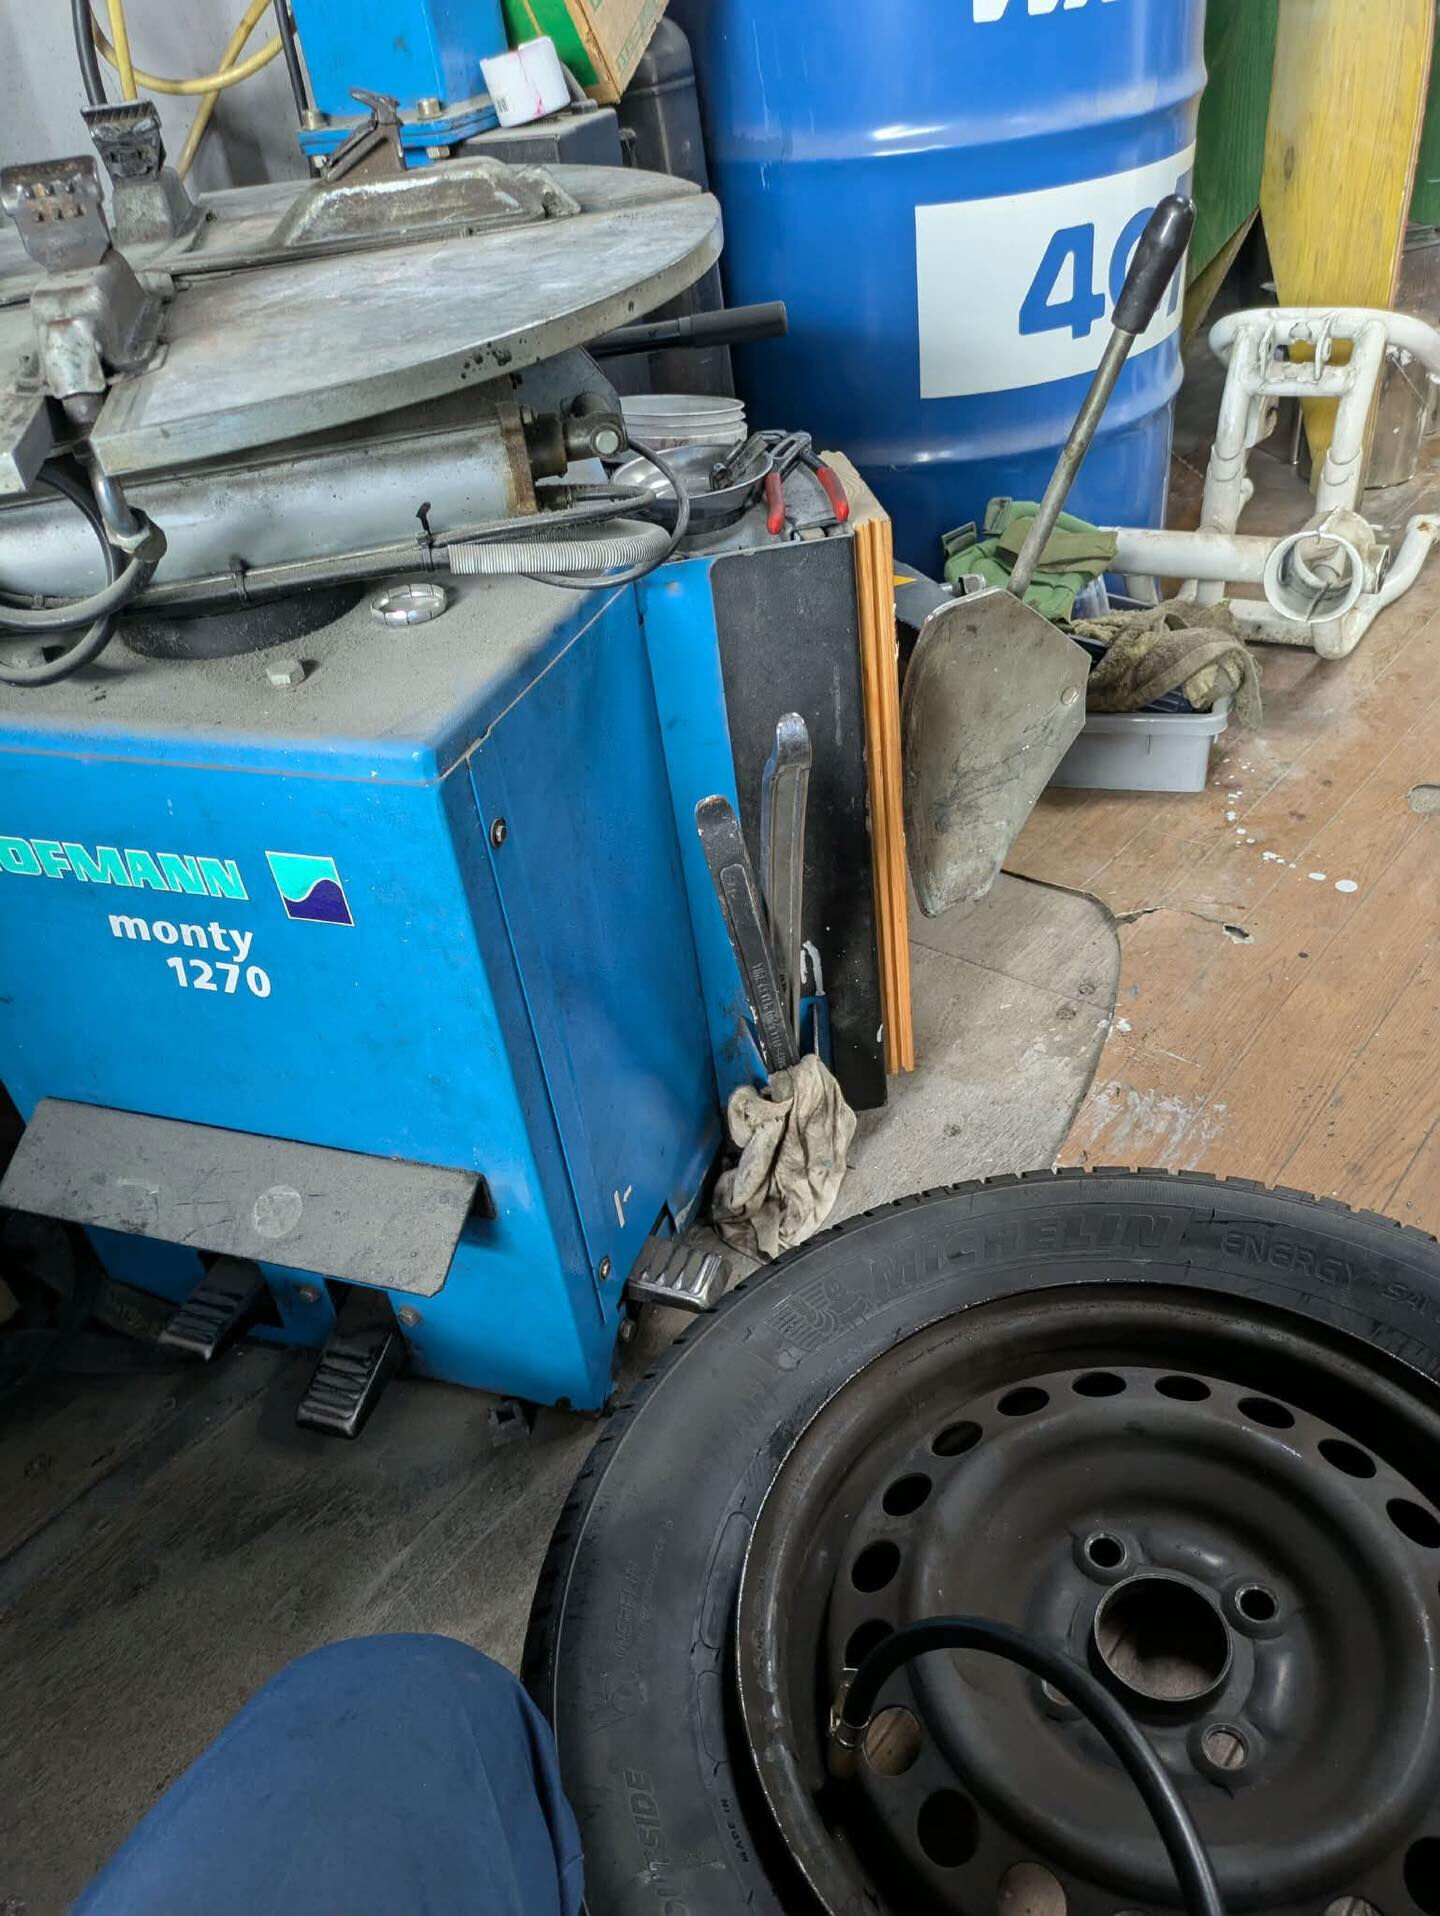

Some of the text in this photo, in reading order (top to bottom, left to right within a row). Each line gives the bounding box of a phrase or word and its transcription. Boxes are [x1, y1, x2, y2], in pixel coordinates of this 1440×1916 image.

[0, 835, 250, 900] OFMANN
[108, 913, 253, 963] monty
[166, 956, 271, 998] 1270
[870, 1209, 1178, 1294] MICHELIN
[1219, 1229, 1360, 1286] ENERGY
